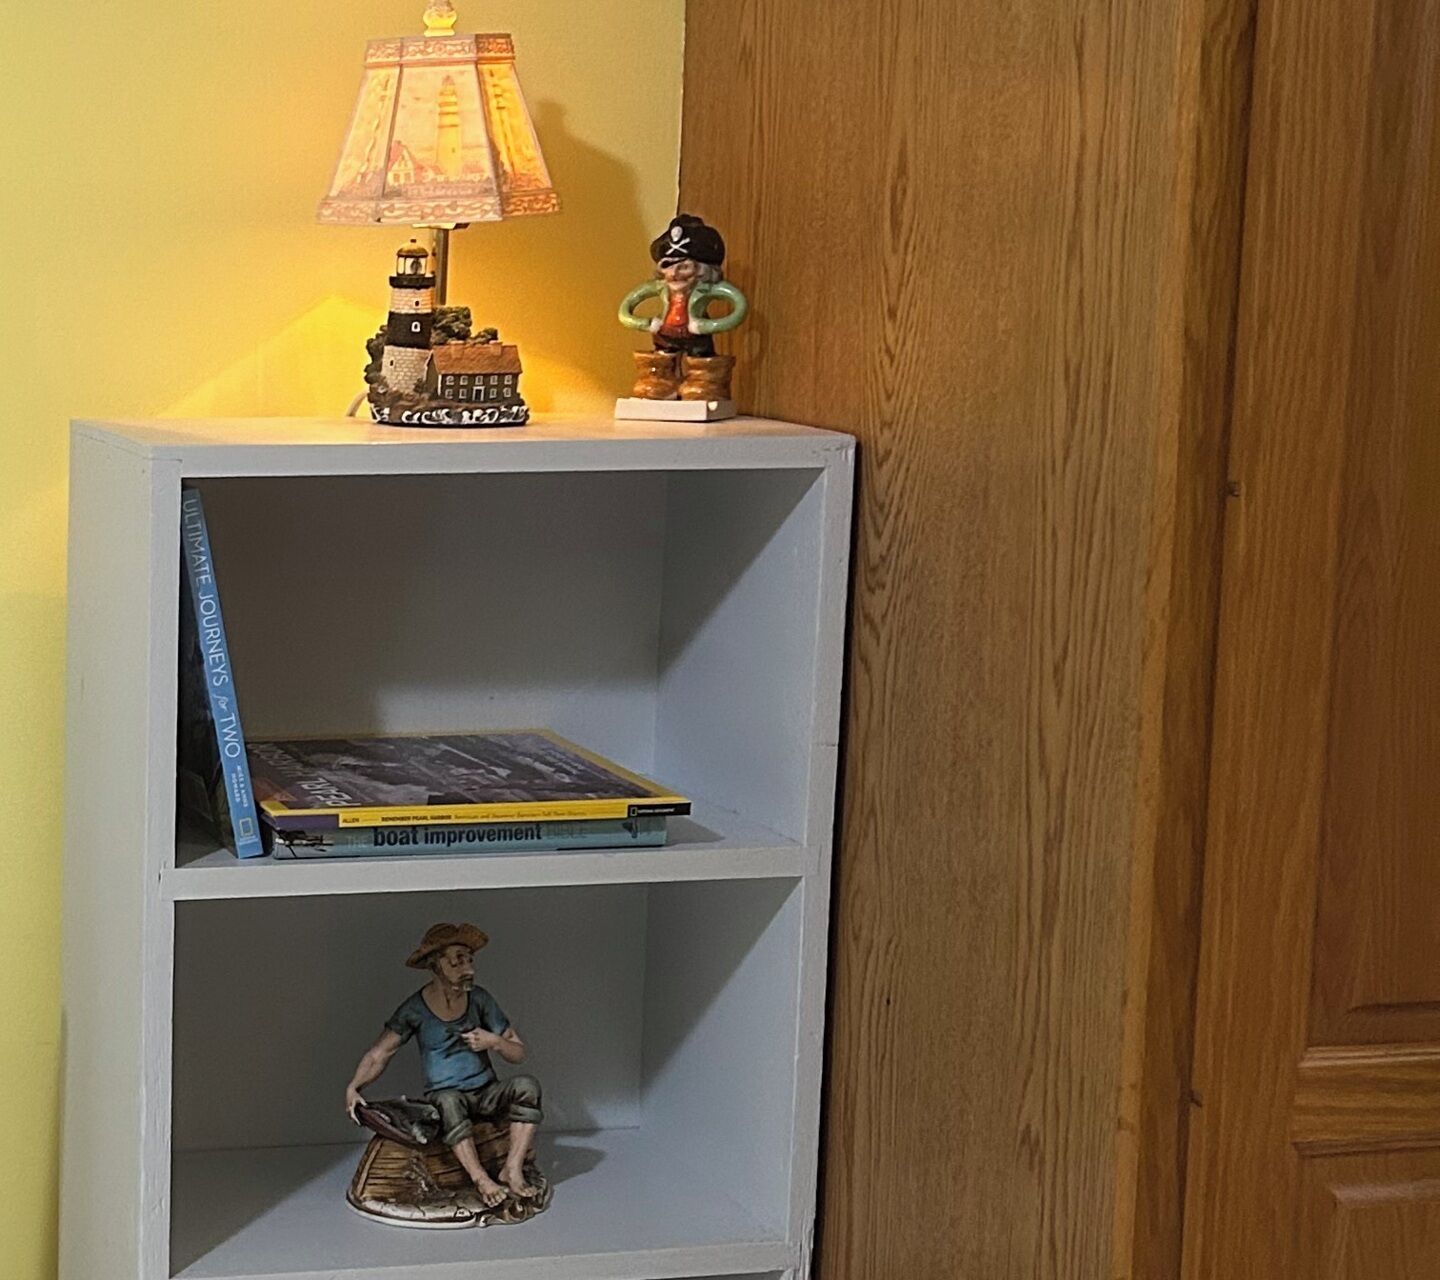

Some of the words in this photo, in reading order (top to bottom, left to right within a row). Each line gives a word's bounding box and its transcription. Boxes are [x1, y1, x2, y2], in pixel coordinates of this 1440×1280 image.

[182, 499, 212, 586] ULTIMATE
[198, 594, 230, 687] JOURNEYS
[218, 713, 241, 758] TWO
[295, 776, 361, 807] PEARL
[372, 825, 420, 848] boat
[424, 823, 543, 847] improvement
